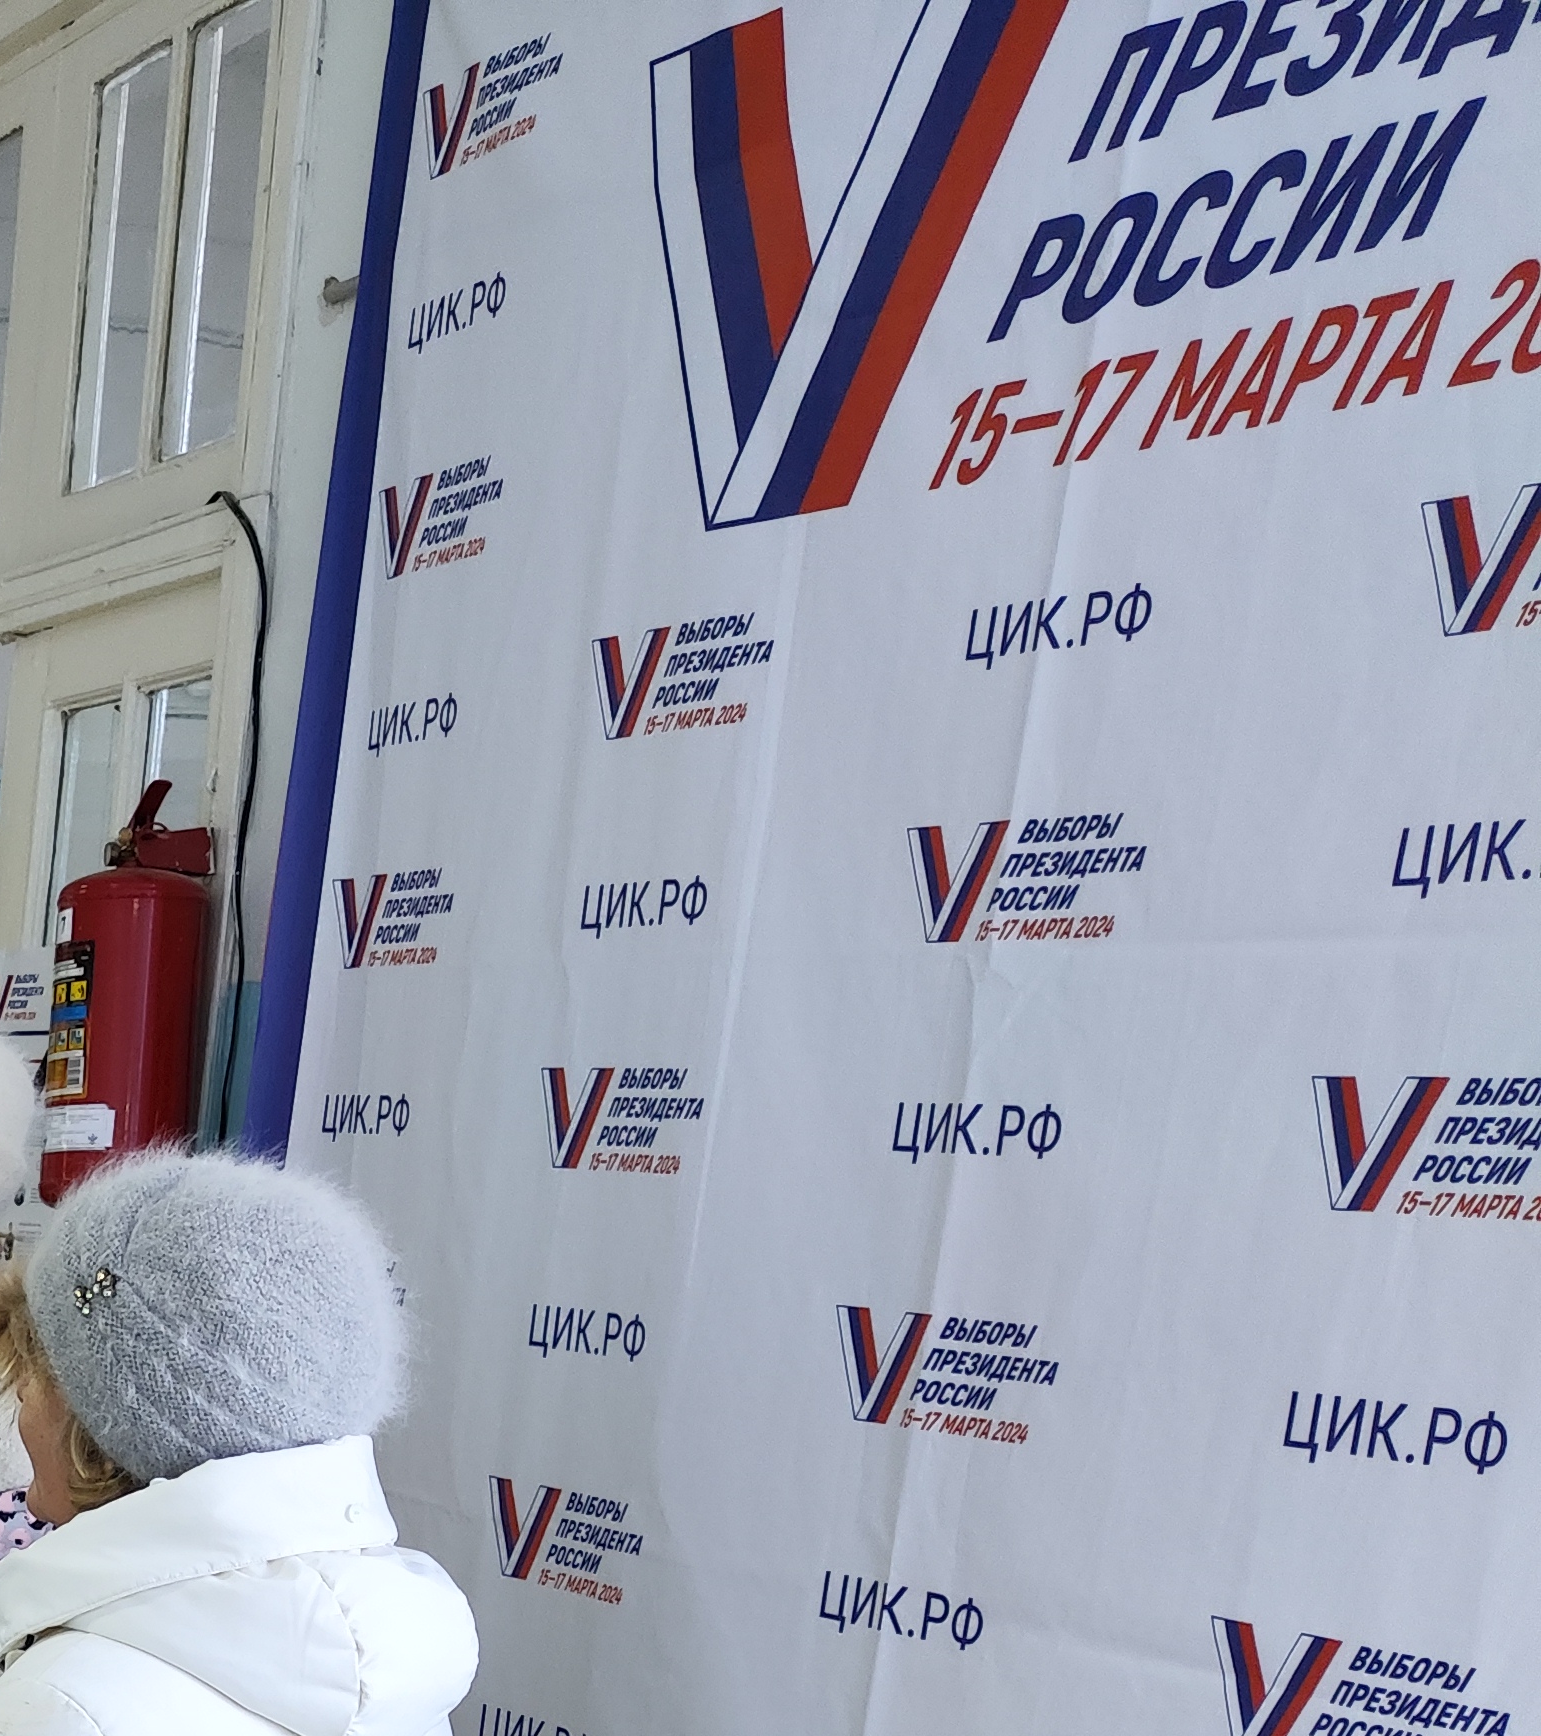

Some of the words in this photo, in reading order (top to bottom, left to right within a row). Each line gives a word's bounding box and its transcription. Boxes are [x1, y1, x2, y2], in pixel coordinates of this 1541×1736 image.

[1068, 0, 1541, 163] ПРЕЗИД
[987, 95, 1487, 342] РОССИИ
[407, 272, 508, 353] ЦИК.РФ
[1139, 279, 1454, 450] МАРТА
[437, 455, 490, 491] ВЫБОРЫ
[428, 478, 504, 520] ПРЕЗИДЕНТА
[419, 515, 468, 548] РОССИИ
[675, 612, 755, 648] ВЫБОРЫ
[966, 581, 1154, 671] ЦИК.РФ
[1516, 600, 1541, 628] 15
[664, 639, 774, 678] ПРЕЗИДЕНТА
[652, 678, 720, 709] РОССИИ
[368, 693, 458, 757] ЦИК.РФ
[674, 707, 714, 730] МАРТА
[715, 702, 747, 725] 2024
[1018, 813, 1124, 844] ВЫБОРЫ
[1000, 846, 1147, 879] ПРЕЗИДЕНТА
[1392, 818, 1541, 899] ЦИК.
[391, 867, 442, 893] ВЫБОРЫ
[382, 893, 453, 919] ПРЕЗИДЕНТА
[580, 875, 708, 938] ЦИК.РФ
[986, 884, 1080, 913] РОССИИ
[374, 923, 420, 945] РОССИИ
[1017, 917, 1074, 941] МАРТА
[1073, 915, 1116, 939] 2024
[391, 948, 418, 965] МАРТА
[418, 946, 437, 963] 2024
[619, 1067, 688, 1091] ВЫБОРЫ
[1456, 1077, 1541, 1106] ВЫБО
[321, 1093, 410, 1142] ЦИК.РФ
[607, 1097, 704, 1122] ПРЕЗИДЕНТА
[596, 1126, 659, 1149] РОССИИ
[892, 1102, 1062, 1164] ЦИК.РФ
[617, 1154, 653, 1174] МАРТА
[652, 1156, 681, 1175] 2024
[1413, 1155, 1532, 1185] РОССИИ
[1456, 1194, 1529, 1220] МАРТА
[528, 1303, 646, 1363] ЦИК.РФ
[939, 1316, 1038, 1349] ВЫБОРЫ
[922, 1347, 1059, 1387] ПРЕЗИДЕНТА
[909, 1378, 997, 1412] РОССИИ
[938, 1415, 992, 1440] МАРТА
[990, 1421, 1029, 1446] 2024
[1283, 1391, 1509, 1475] ЦИК.РФ
[566, 1492, 629, 1524] ВЫБОРЫ
[555, 1518, 643, 1556] ПРЕЗИДЕНТА
[545, 1544, 603, 1575] РОССИИ
[566, 1575, 600, 1600] МАРТА
[597, 1584, 623, 1606] 2024
[818, 1570, 984, 1651] ЦИК.РФ
[1349, 1646, 1476, 1695] ВЫБОРЫ
